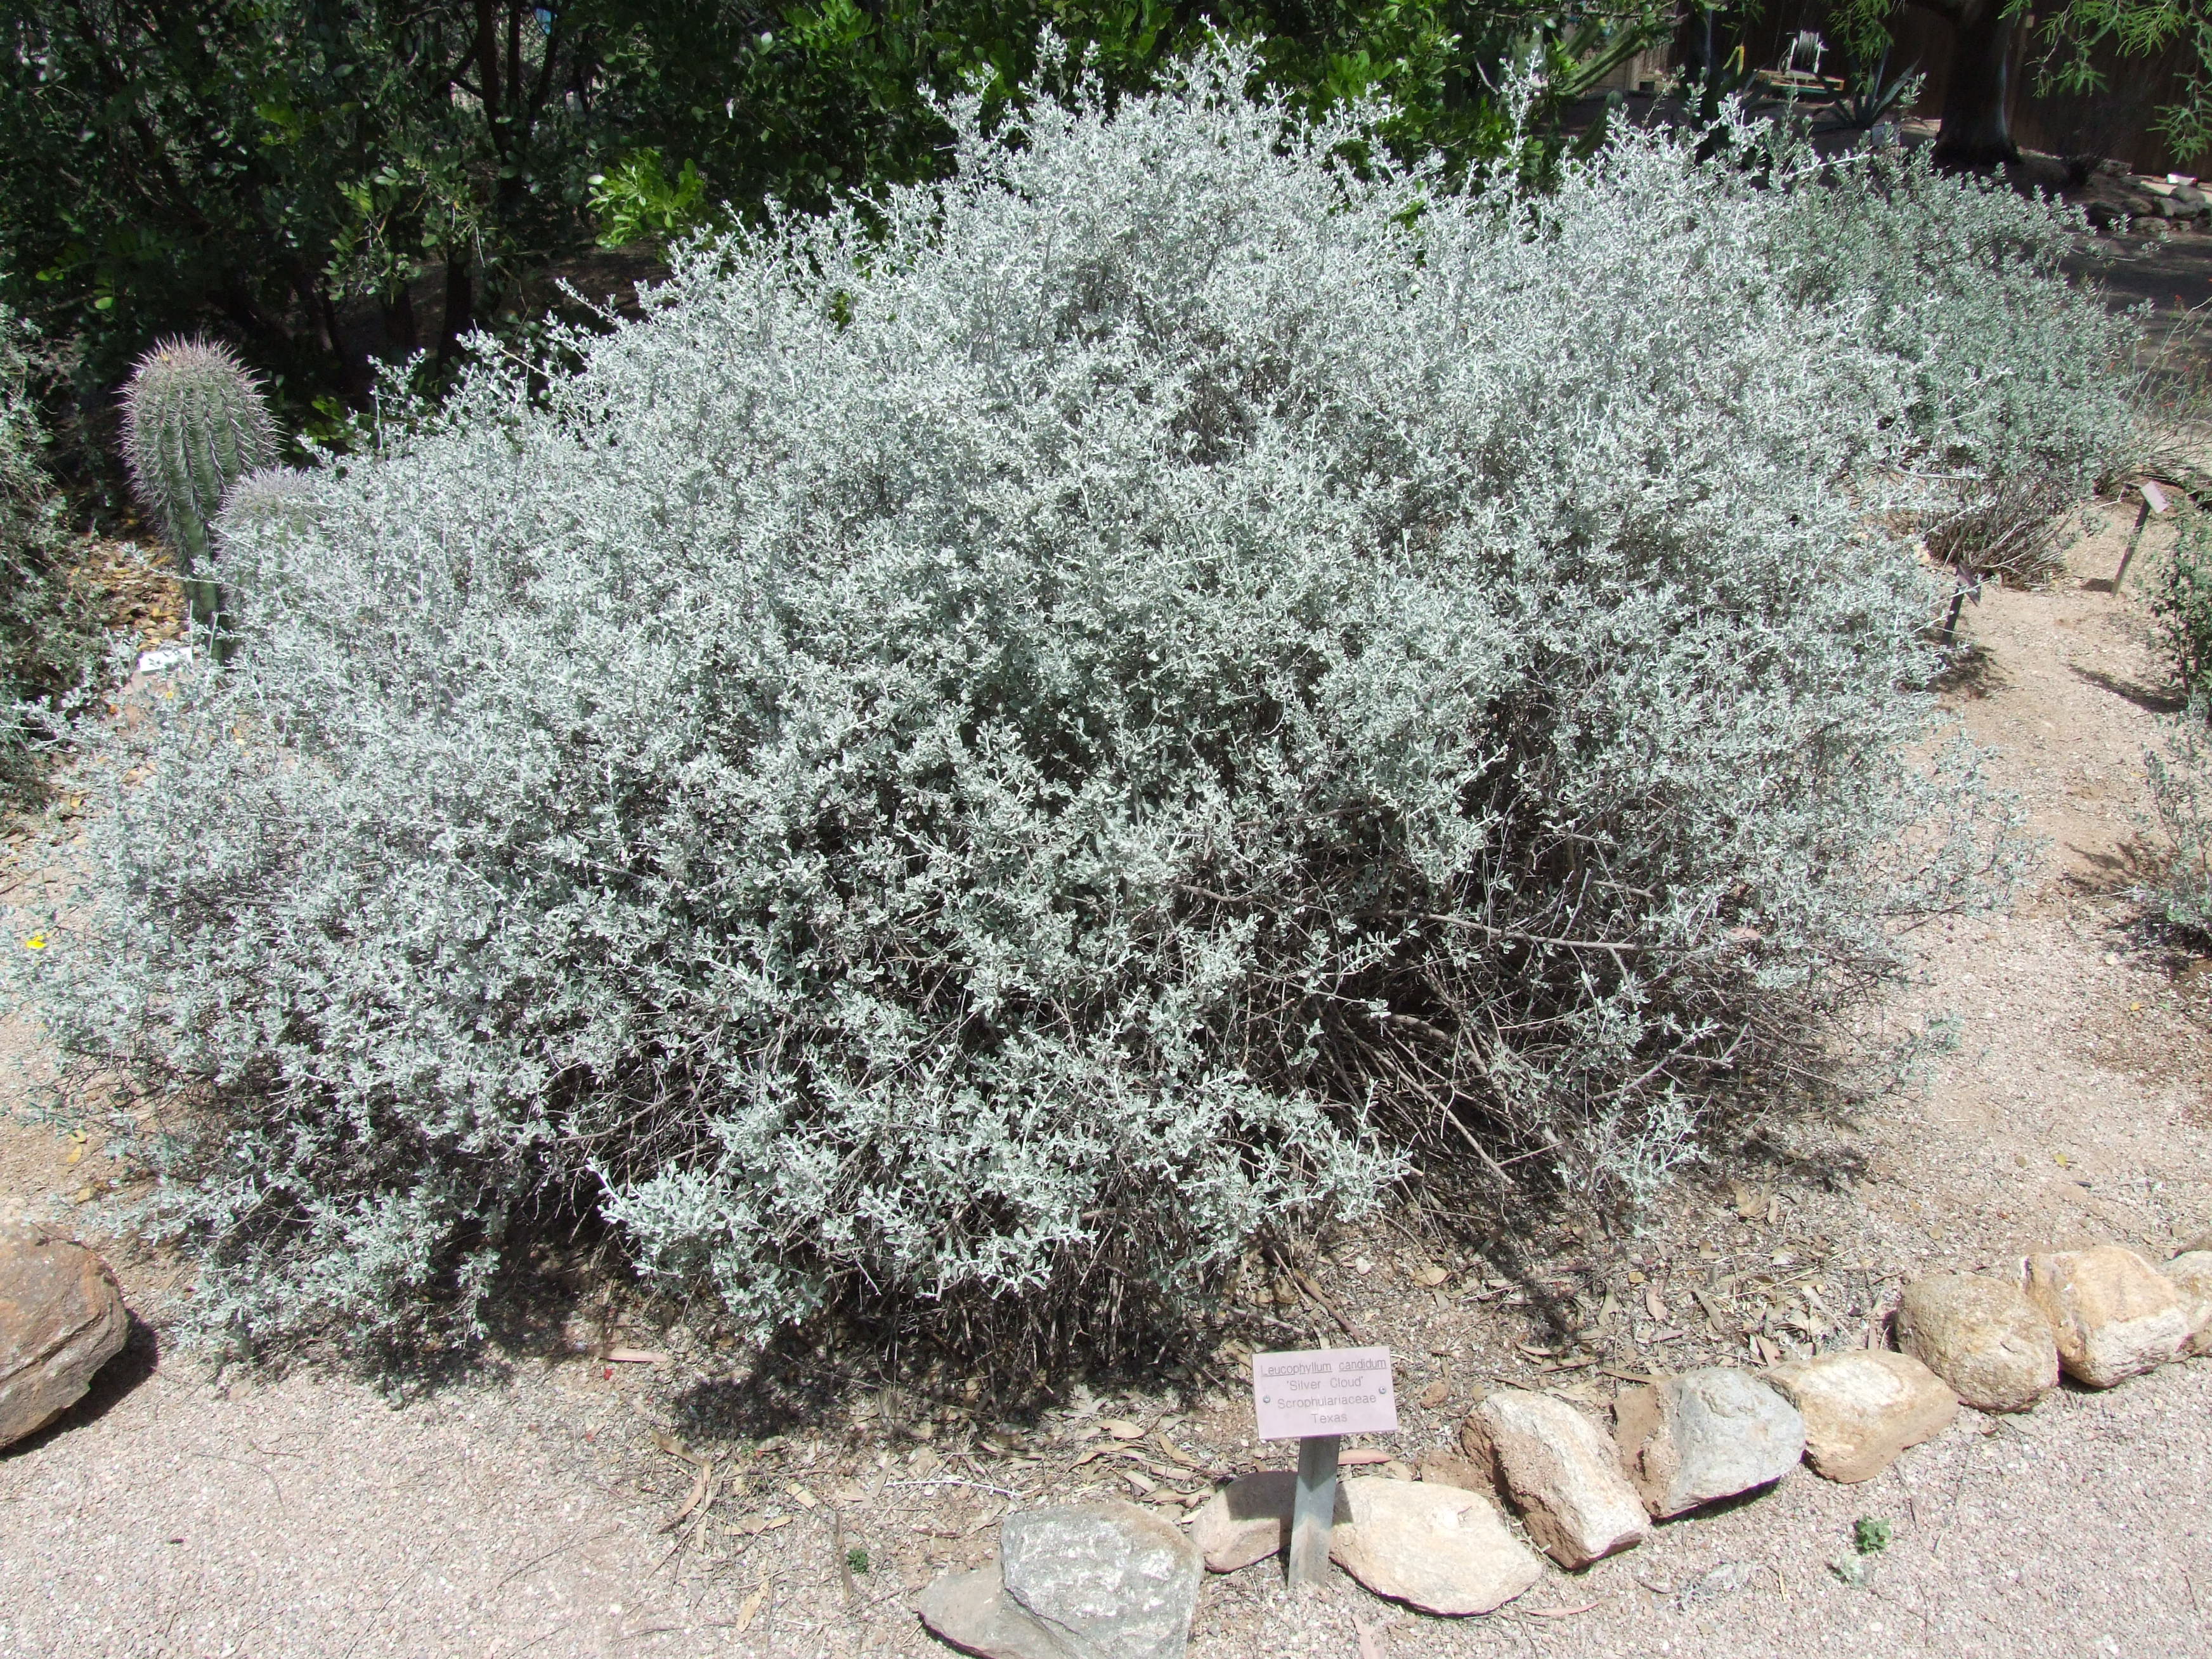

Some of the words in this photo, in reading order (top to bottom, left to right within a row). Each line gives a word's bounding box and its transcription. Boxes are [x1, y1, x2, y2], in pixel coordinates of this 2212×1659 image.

[1260, 1362, 1332, 1376] Leucophyllum
[1339, 1358, 1386, 1370] candidum
[1286, 1381, 1321, 1391] 'Silver
[1330, 1376, 1363, 1388] Cloud'
[1278, 1394, 1376, 1409] Scrophulariaceae
[1311, 1413, 1347, 1424] Texas
